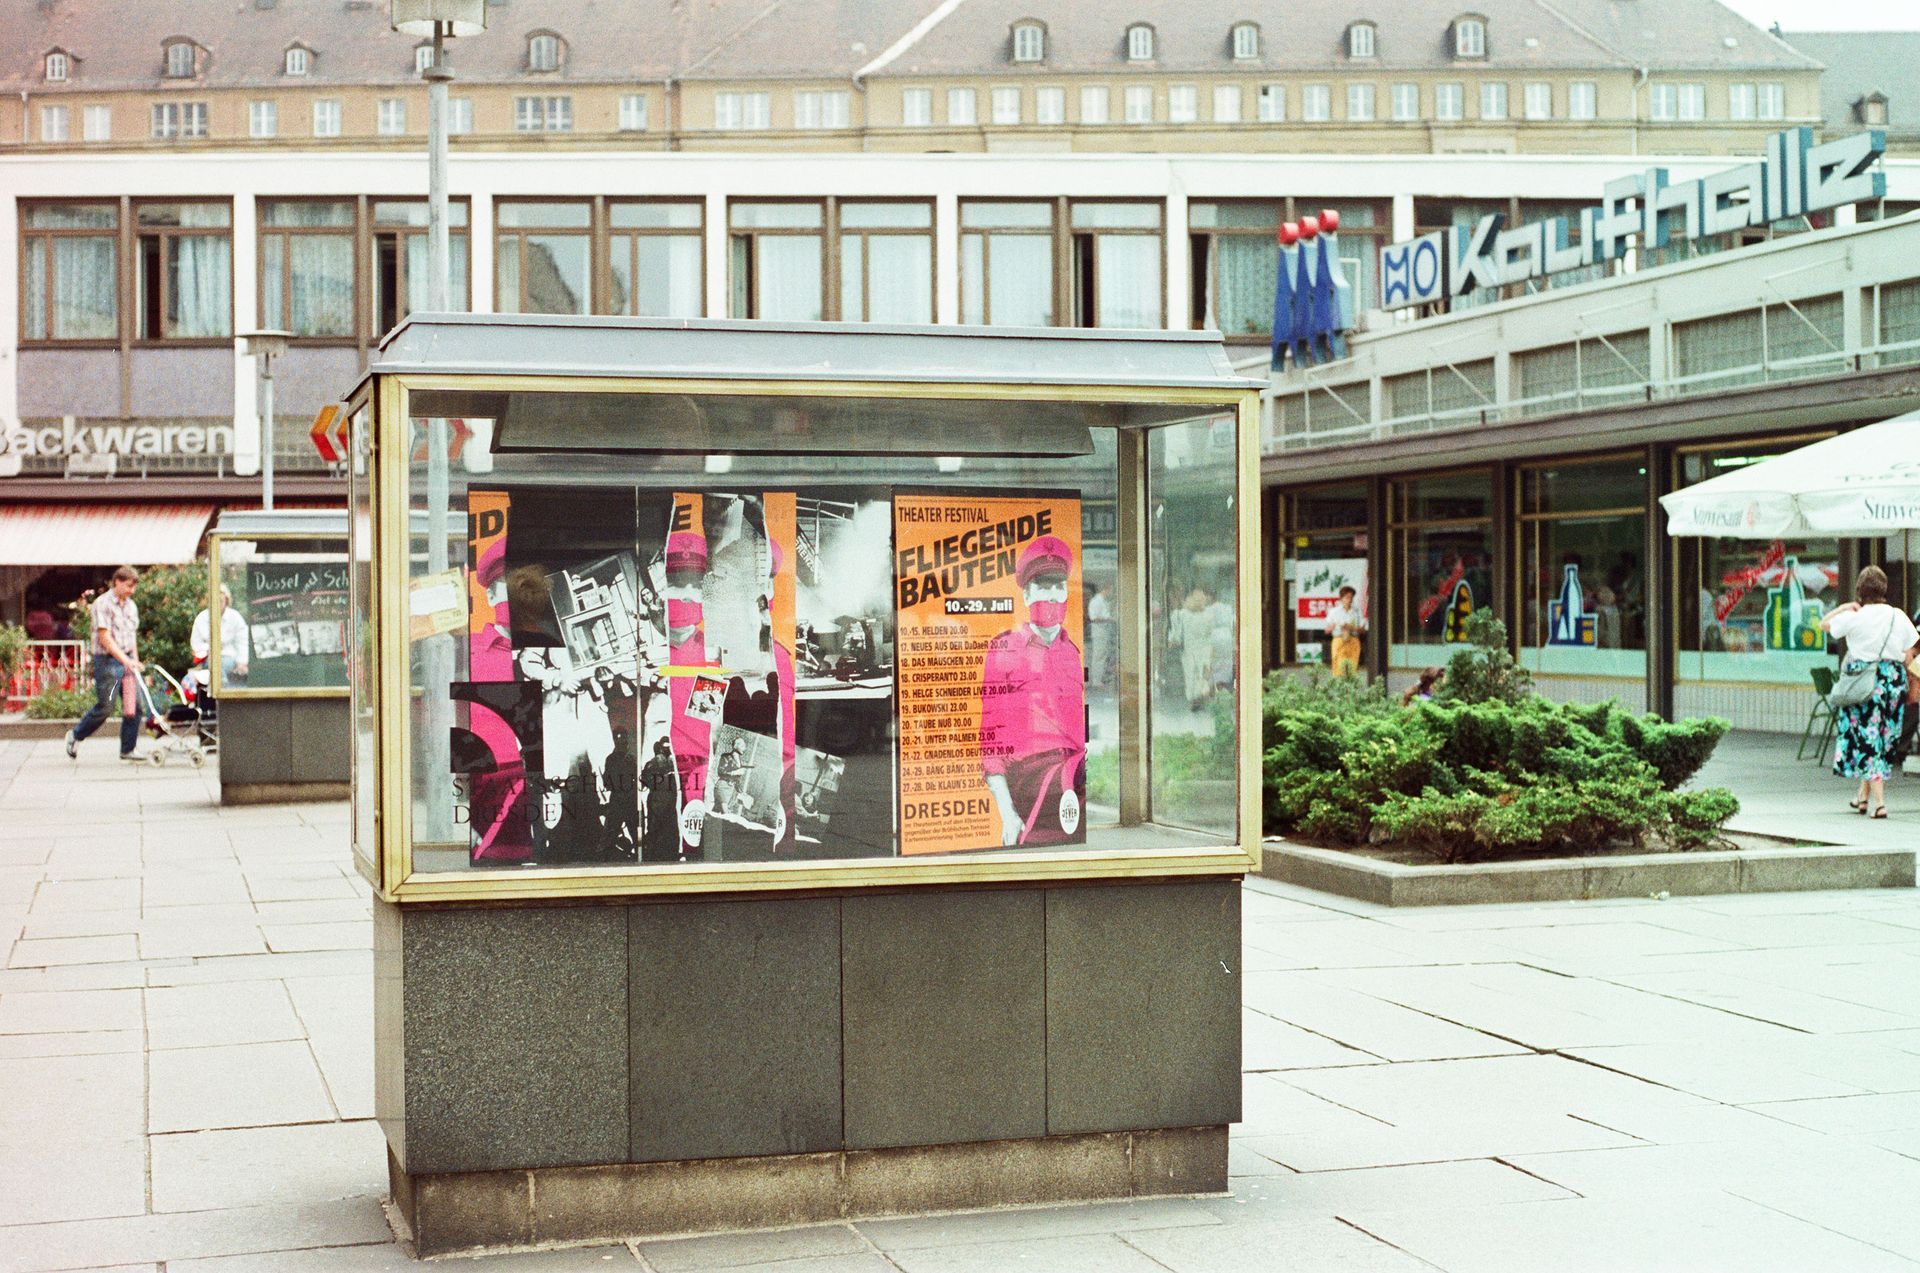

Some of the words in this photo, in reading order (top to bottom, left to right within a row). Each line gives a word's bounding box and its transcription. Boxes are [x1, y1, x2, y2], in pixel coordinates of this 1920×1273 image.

[1449, 127, 1886, 297] Kaufhalle
[671, 504, 692, 532] E
[899, 507, 942, 522] THEATER
[945, 508, 989, 523] FESTIVAL
[1863, 499, 1920, 525] Stuyve
[900, 509, 1051, 579] FLIEGENDE
[255, 572, 299, 591] Dussel
[901, 549, 1016, 609] BAUTEN
[946, 600, 987, 612] 10.-29.
[991, 599, 1013, 611] Juli
[1308, 600, 1339, 617] SPA
[922, 626, 948, 635] HELDEN
[950, 626, 968, 634] 20.00
[901, 643, 909, 651] 17.
[911, 642, 932, 651] NEUES
[935, 642, 947, 650] AUS
[990, 640, 1008, 649] 20.00
[901, 658, 910, 667] 18.
[912, 658, 925, 667] DAS
[966, 656, 983, 665] 20.00
[901, 674, 910, 683] 18.
[912, 672, 958, 682] CRISPERANTO
[960, 671, 977, 680] 23.00
[901, 690, 910, 698] 19.
[913, 689, 933, 698] HELGE
[935, 687, 971, 697] SCHNEIDER
[973, 686, 987, 695] LIVE
[989, 685, 1007, 695] 20.00
[902, 705, 911, 714] 19.
[913, 703, 948, 713] BUKOWSKI
[950, 702, 967, 712] 23.00
[902, 721, 911, 730] 20.
[914, 719, 936, 729] TAUBE
[954, 718, 972, 727] 20.00
[925, 734, 946, 744] UNTER
[949, 733, 976, 743] PALMEN
[978, 732, 995, 741] 23.00
[924, 749, 963, 759] GNADENLOS
[966, 747, 995, 757] DEUTSCH
[997, 746, 1014, 755] 20.00
[926, 765, 944, 775] BANG
[947, 764, 965, 774] BANG
[967, 763, 985, 773] 20.00
[453, 801, 577, 825] DRESDEN
[904, 798, 990, 820] DRESDEN
